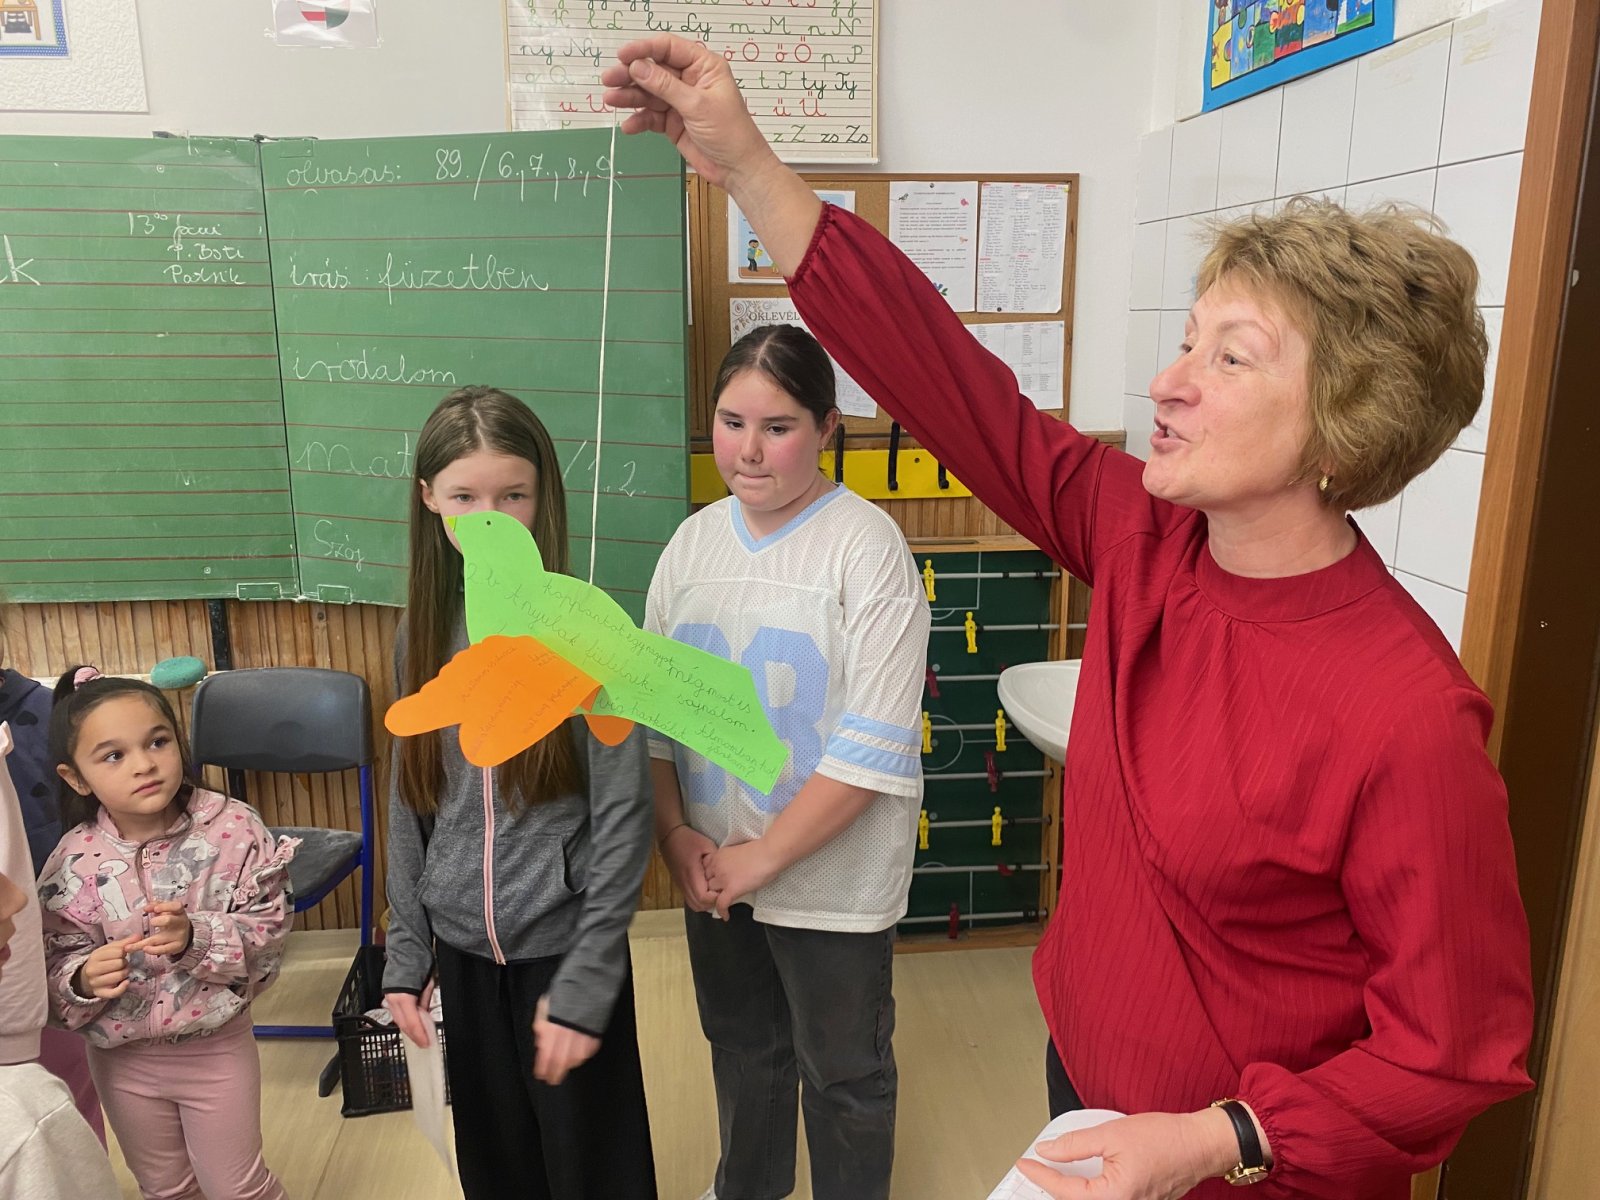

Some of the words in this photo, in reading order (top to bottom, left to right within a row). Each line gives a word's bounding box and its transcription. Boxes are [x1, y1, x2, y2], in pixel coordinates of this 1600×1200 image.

[606, 10, 623, 30] L
[680, 13, 712, 42] Ly
[729, 22, 755, 34] m
[763, 16, 791, 34] M
[808, 25, 826, 36] n
[832, 18, 862, 36] N
[520, 44, 555, 66] ny
[562, 38, 602, 67] Ny
[822, 53, 840, 72] p
[846, 44, 863, 64] P
[758, 70, 770, 89] t
[778, 70, 793, 90] T
[801, 71, 827, 100] ty
[834, 72, 858, 100] Ty
[560, 102, 578, 112] u
[774, 132, 784, 143] z
[791, 124, 806, 143] Z
[820, 132, 839, 144] zs
[846, 124, 869, 144] Zs
[379, 252, 549, 305] füzetben
[749, 309, 800, 321] OKLEVÉL
